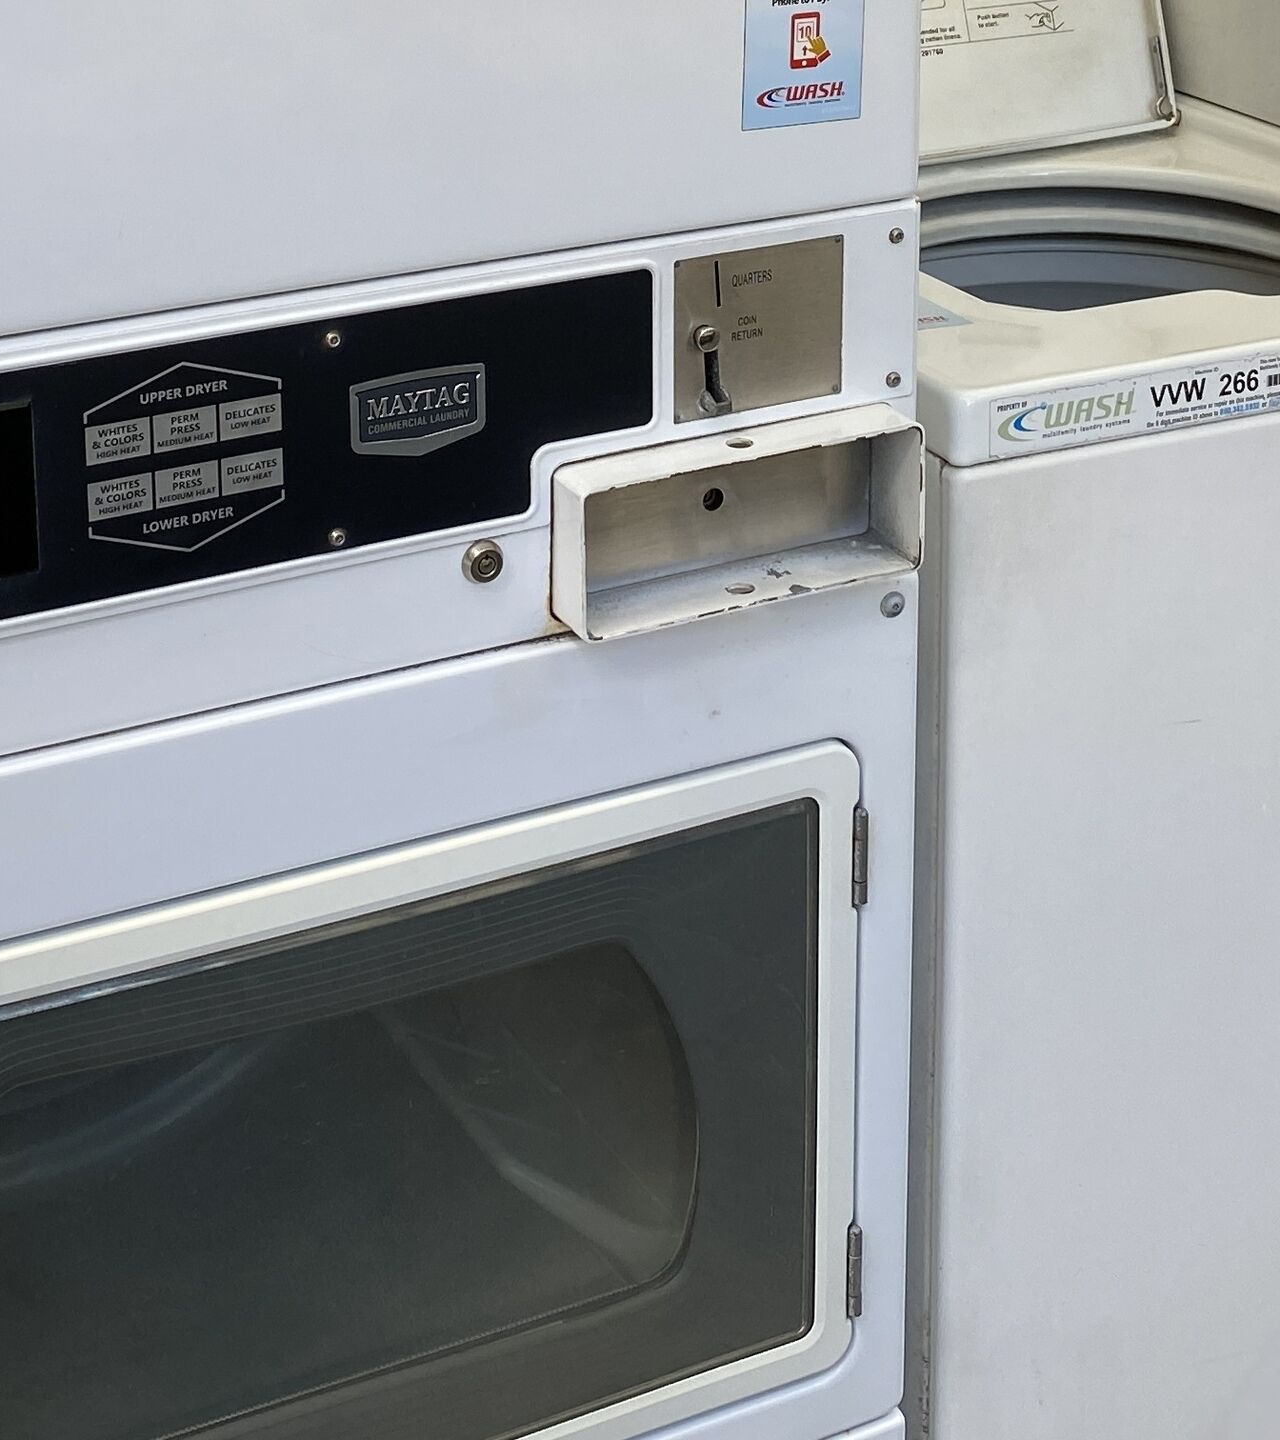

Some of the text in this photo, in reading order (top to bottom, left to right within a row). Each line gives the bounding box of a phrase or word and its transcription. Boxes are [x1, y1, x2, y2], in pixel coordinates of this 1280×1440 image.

[798, 25, 811, 39] 10
[786, 81, 843, 101] WASH
[732, 269, 772, 287] QUARTERS
[738, 315, 757, 326] COIN
[731, 328, 763, 341] RETURN
[139, 380, 229, 405] UPPER DRYER
[1150, 369, 1259, 408] VVW 266
[367, 382, 470, 420] MAYTAG
[225, 403, 276, 421] DELICATES
[1044, 390, 1135, 429] WASH
[171, 412, 199, 425] PERM
[230, 416, 272, 430] LOW HEAT
[368, 407, 470, 435] COMMERCIAL LAUNDRY
[98, 423, 138, 438] WHITES
[170, 422, 201, 435] PRESS
[92, 432, 145, 449] & COLORS
[157, 432, 214, 448] MEDIUM HEAT
[96, 445, 141, 459] HIGH HEAT
[173, 467, 201, 480] PERM
[227, 458, 277, 475] DELICATES
[172, 478, 203, 490] PRESS
[232, 471, 273, 485] LOW HEAT
[100, 479, 140, 494] WHITES
[94, 488, 147, 505] & COLORS
[159, 486, 216, 504] MEDIUM HEAT
[98, 500, 143, 515] HIGH HEAT
[142, 506, 234, 534] LOWER DRYER
